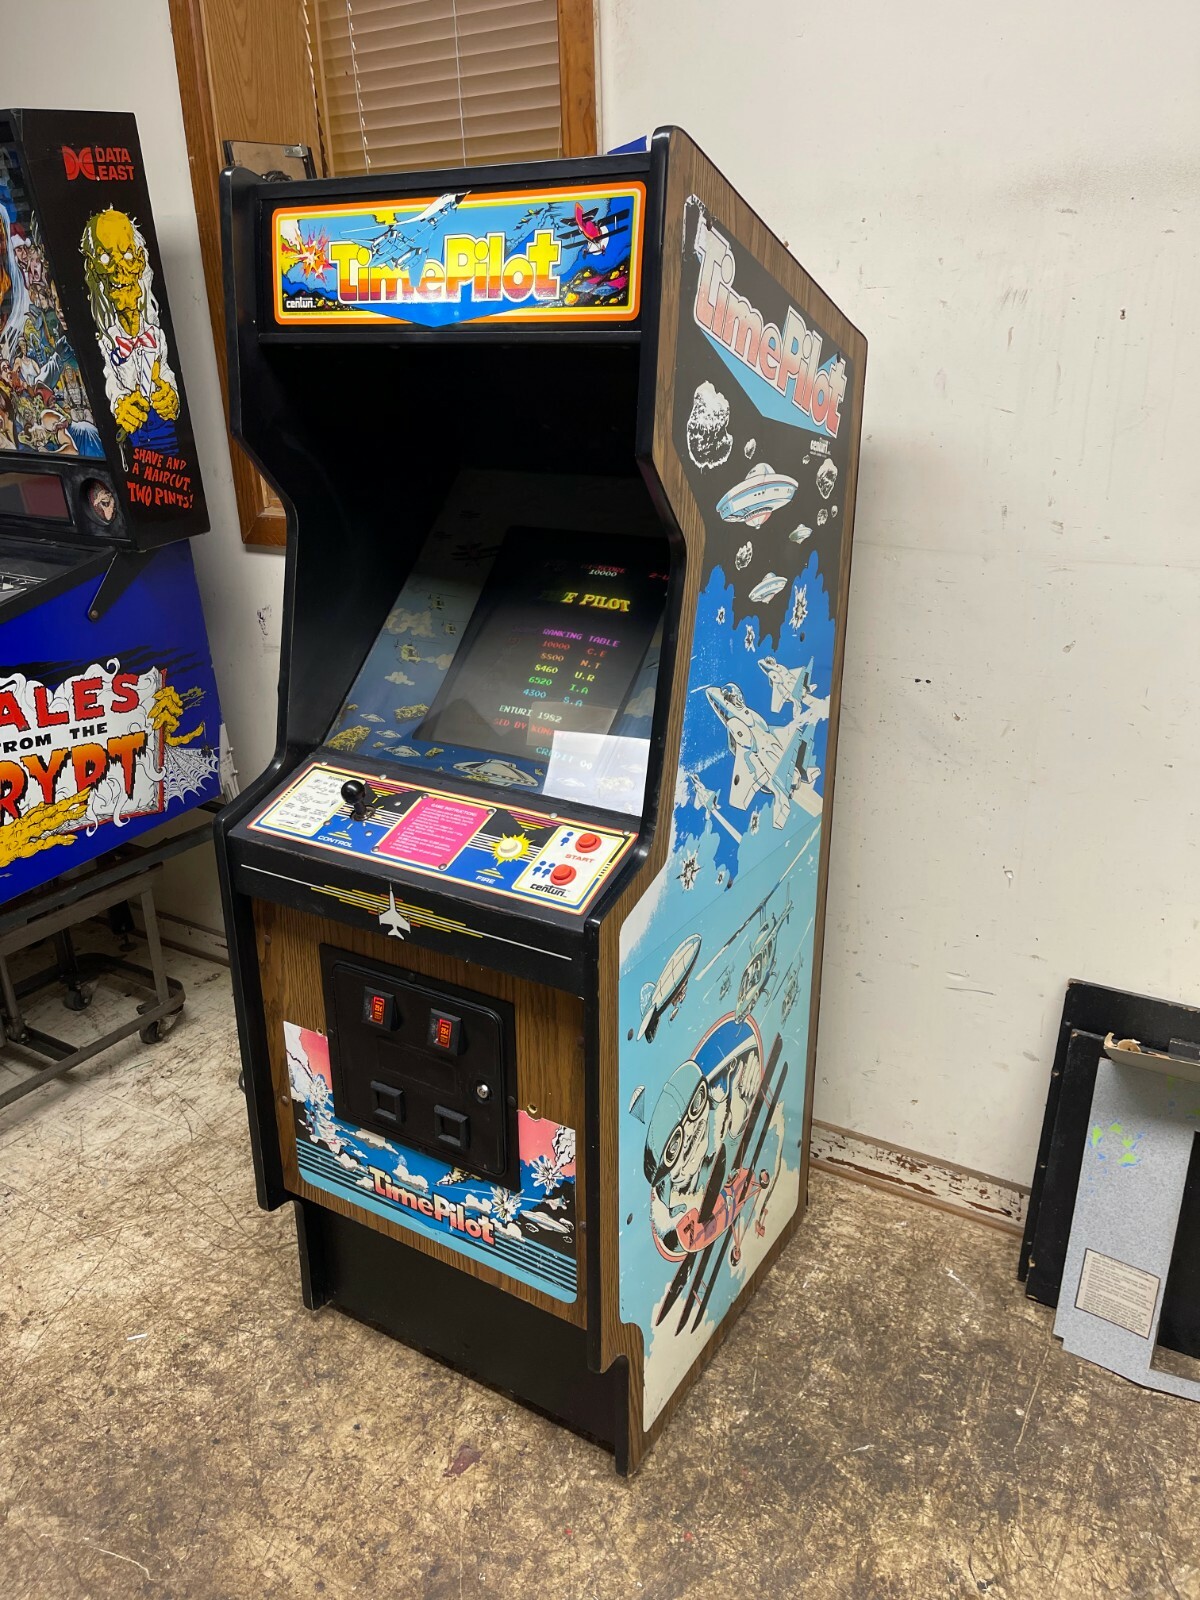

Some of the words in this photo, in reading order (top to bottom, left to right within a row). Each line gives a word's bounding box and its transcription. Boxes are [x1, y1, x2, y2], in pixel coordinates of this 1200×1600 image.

[95, 146, 131, 163] DATA
[98, 163, 135, 181] EAST
[133, 447, 163, 468] SHAVE
[166, 456, 187, 471] AND
[132, 462, 139, 475] A
[127, 481, 152, 507] TWO
[155, 486, 193, 509] PINTS!
[588, 569, 618, 577] 10000
[579, 593, 631, 613] PILOT
[542, 628, 583, 641] RANKING
[588, 636, 621, 648] TABLE
[528, 675, 553, 686] 6520
[522, 688, 547, 699] 4300
[0, 673, 142, 732] ALES
[499, 704, 533, 717] ENTURI
[0, 733, 52, 754] ROM
[70, 722, 108, 741] THE
[0, 731, 148, 823] RYPT
[317, 835, 353, 849] CONTROL
[564, 853, 595, 863] START
[475, 875, 496, 885] FIRE
[368, 1164, 496, 1246] TimePilot
